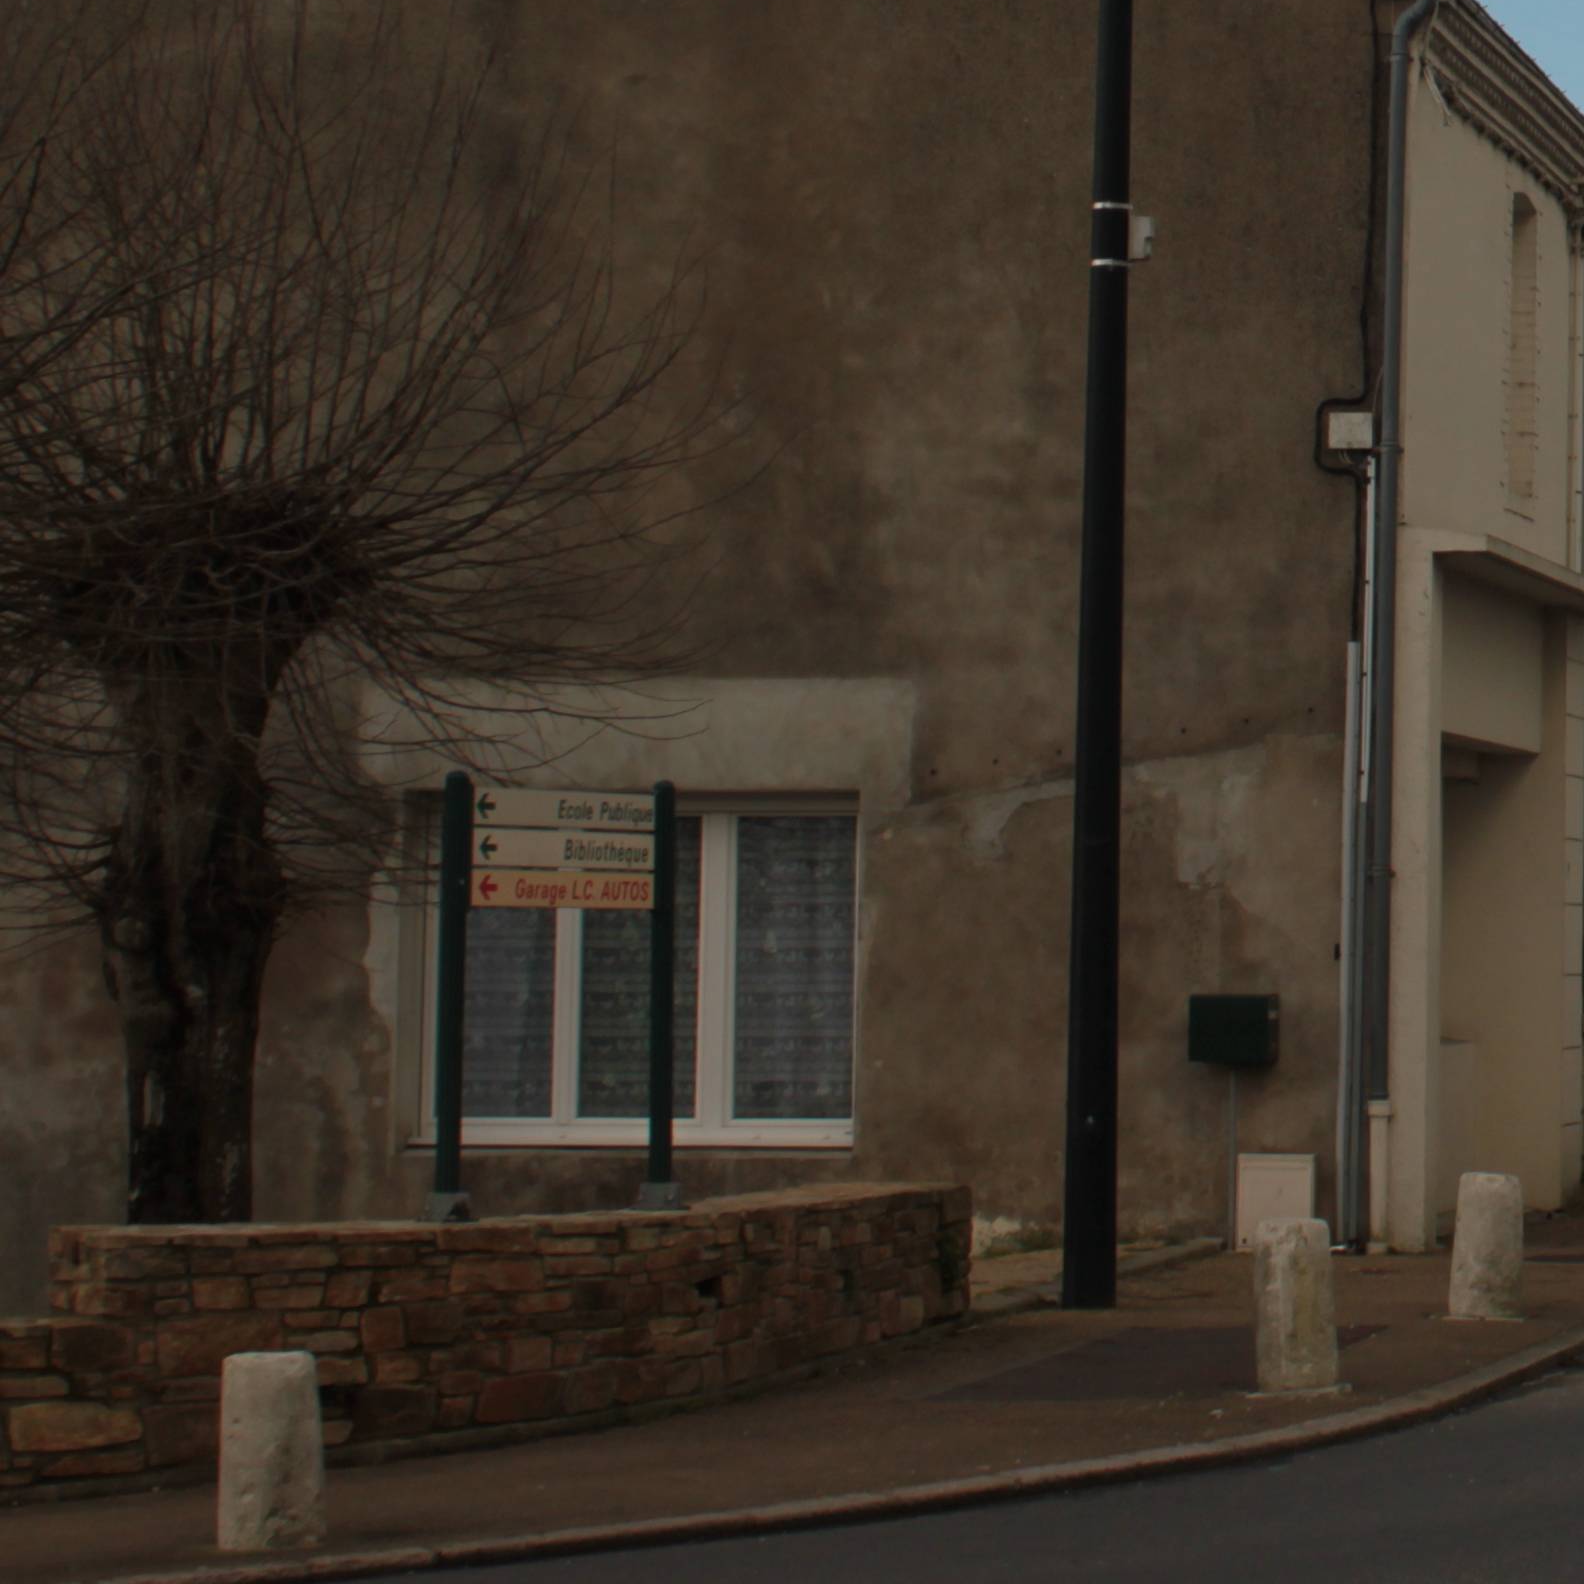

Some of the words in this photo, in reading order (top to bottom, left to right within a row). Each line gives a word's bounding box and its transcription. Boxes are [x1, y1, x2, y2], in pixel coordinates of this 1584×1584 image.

[557, 799, 594, 821] Ecole
[600, 801, 652, 826] Publique
[515, 878, 567, 904] Garage
[601, 881, 650, 902] AUTOS
